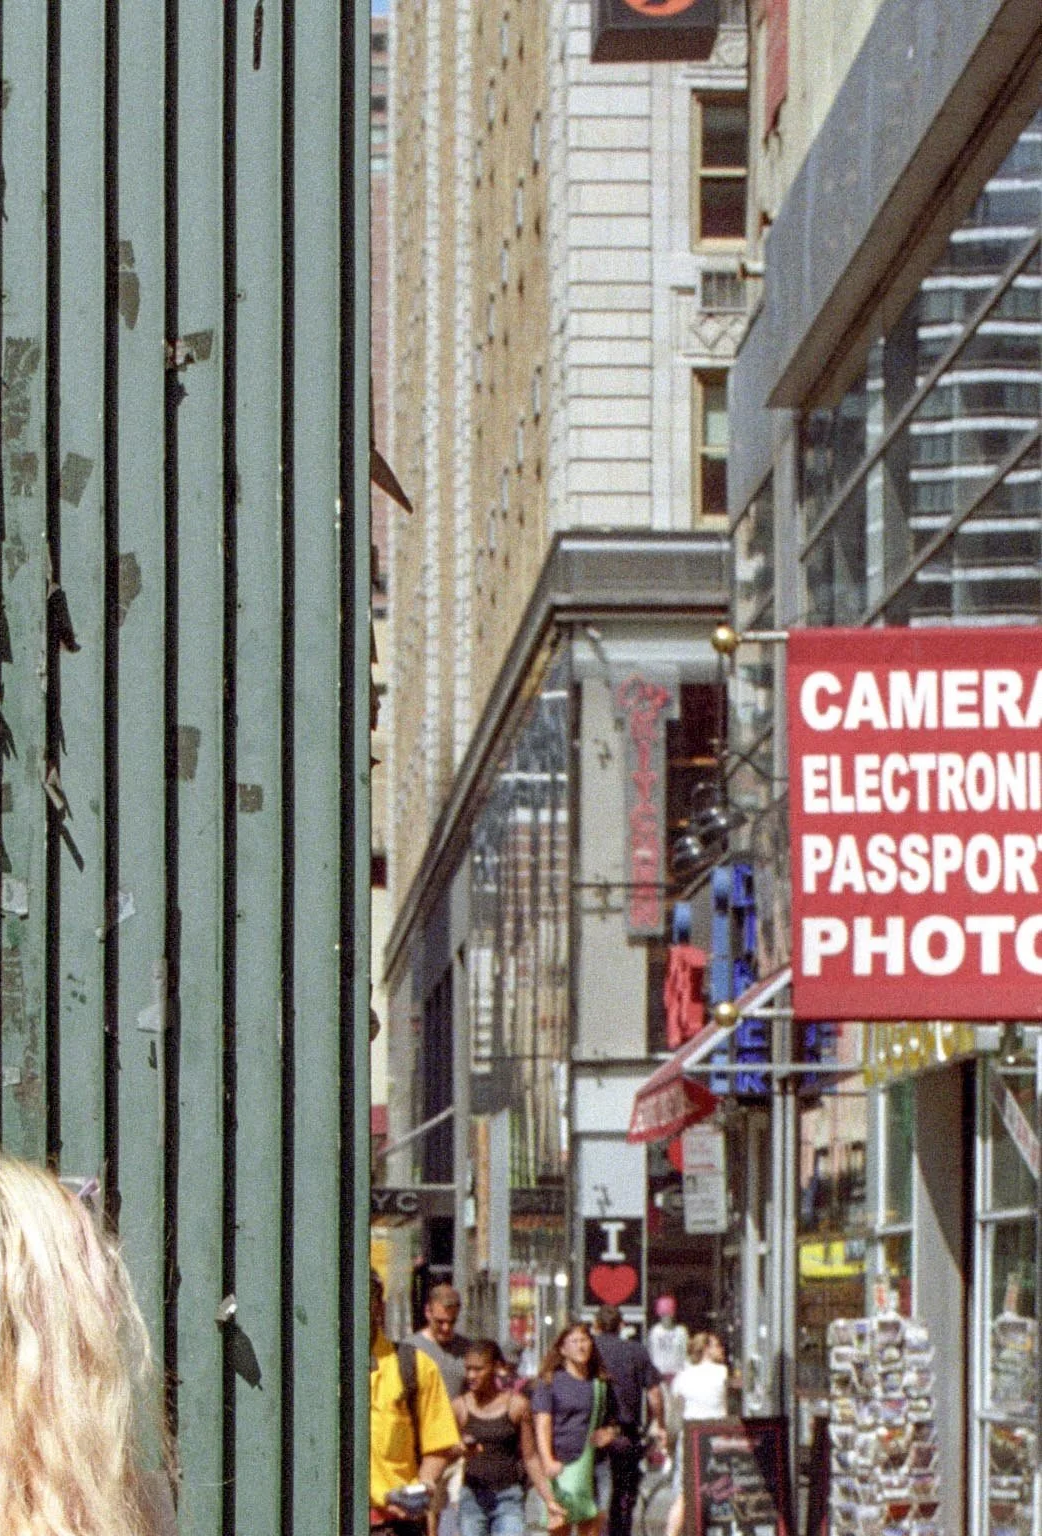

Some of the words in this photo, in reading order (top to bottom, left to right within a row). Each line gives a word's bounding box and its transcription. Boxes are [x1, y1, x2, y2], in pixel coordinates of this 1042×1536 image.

[801, 752, 1041, 814] ELECTRONI
[801, 833, 1042, 894] PASSPOR
[599, 1221, 627, 1262] I
